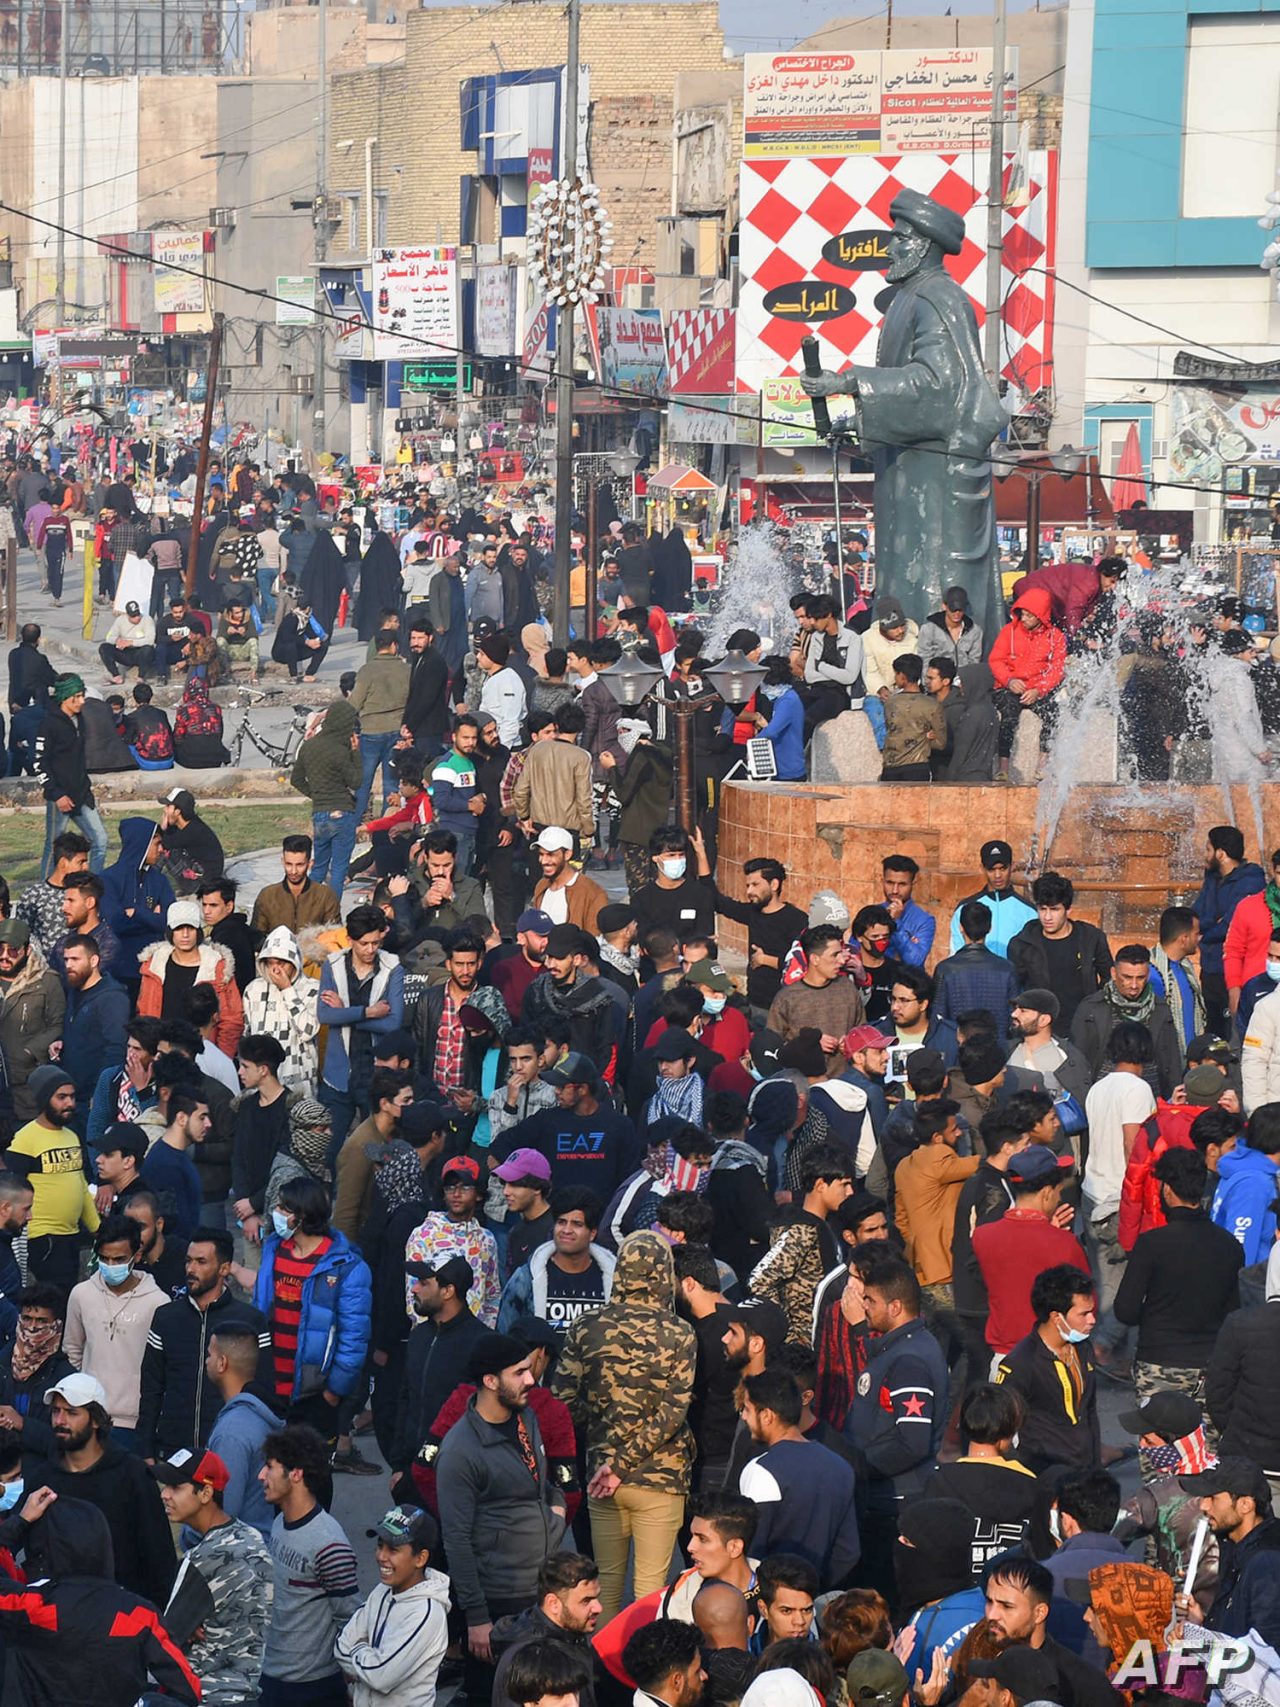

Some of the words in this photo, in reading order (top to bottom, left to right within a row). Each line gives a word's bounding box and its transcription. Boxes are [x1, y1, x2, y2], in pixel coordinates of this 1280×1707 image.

[781, 75, 810, 92] مهدي
[812, 75, 840, 89] داخل
[842, 74, 878, 88] الدكتور
[884, 70, 938, 92] الخفاجي
[942, 72, 977, 87] محسن
[828, 93, 837, 103] في
[400, 249, 431, 261] مجمع
[380, 263, 420, 280] الأسعار
[423, 263, 449, 279] قاهر
[771, 287, 840, 319] المراد
[525, 311, 549, 358] 500
[558, 1132, 605, 1152] EA7
[546, 1302, 603, 1321] TOMM
